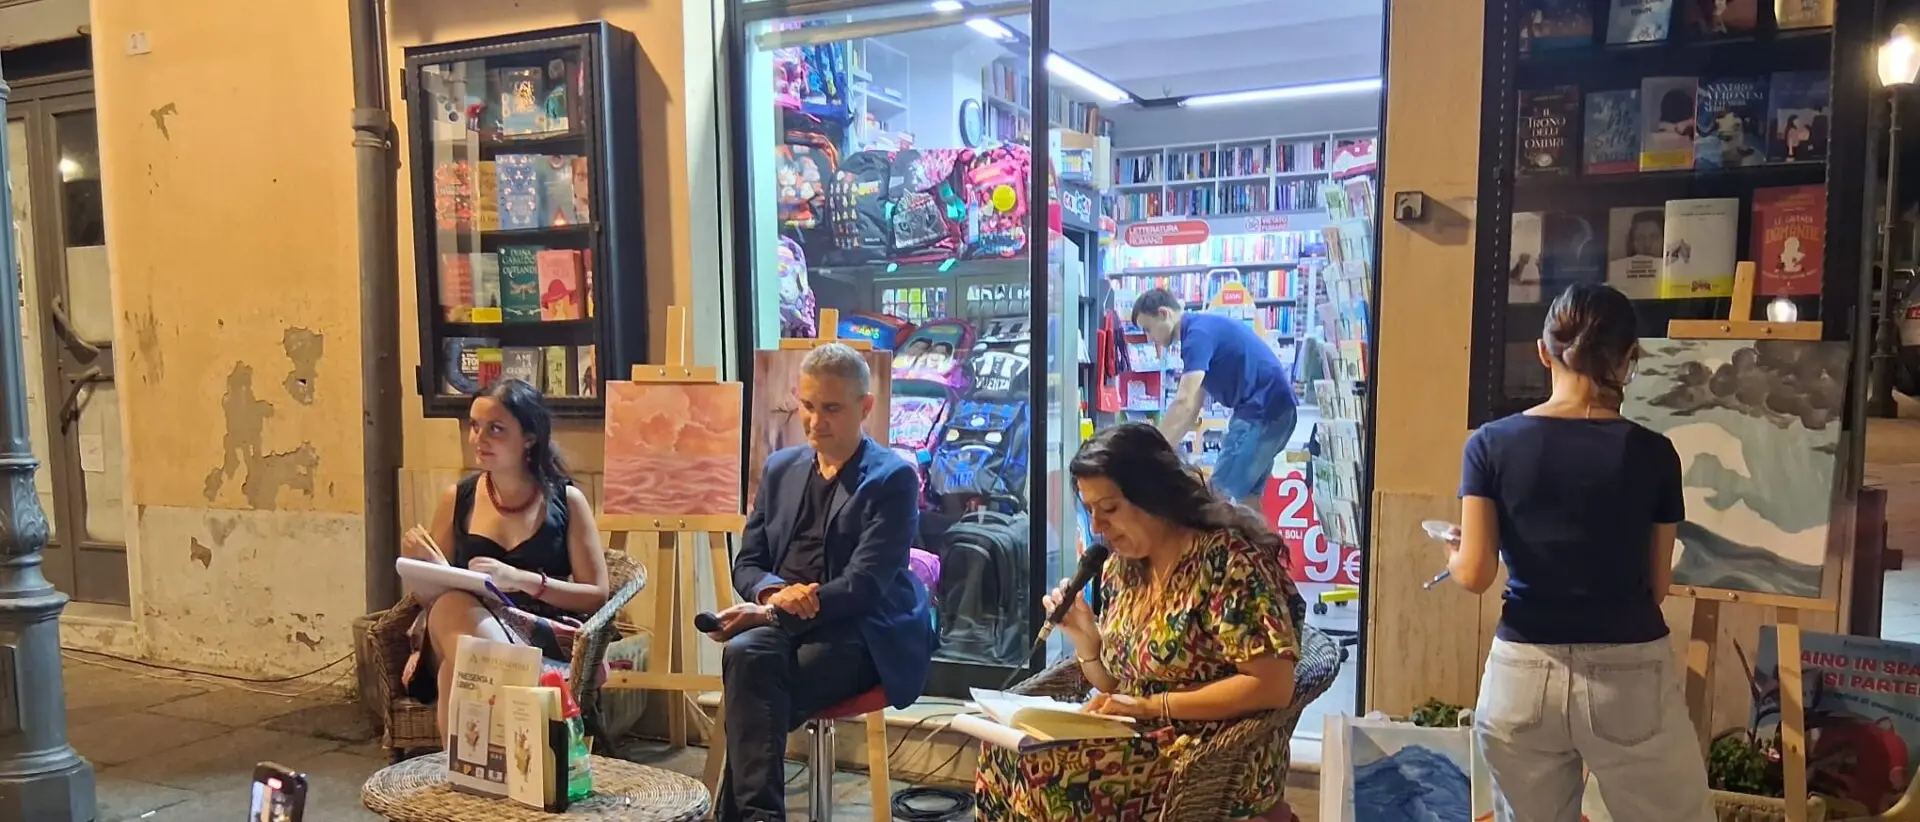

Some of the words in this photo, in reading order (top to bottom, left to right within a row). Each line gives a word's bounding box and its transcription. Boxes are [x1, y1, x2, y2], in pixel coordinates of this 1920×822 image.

[1528, 117, 1567, 128] TRONO
[1128, 223, 1180, 235] LETTERATURA
[502, 256, 537, 266] GABALDO
[502, 266, 537, 278] OUTLAND
[1285, 529, 1303, 540] SOLI
[1800, 650, 1849, 669] AINO
[1852, 656, 1877, 673] IN
[1824, 671, 1845, 688] SI
[1850, 675, 1920, 697] PARTE
